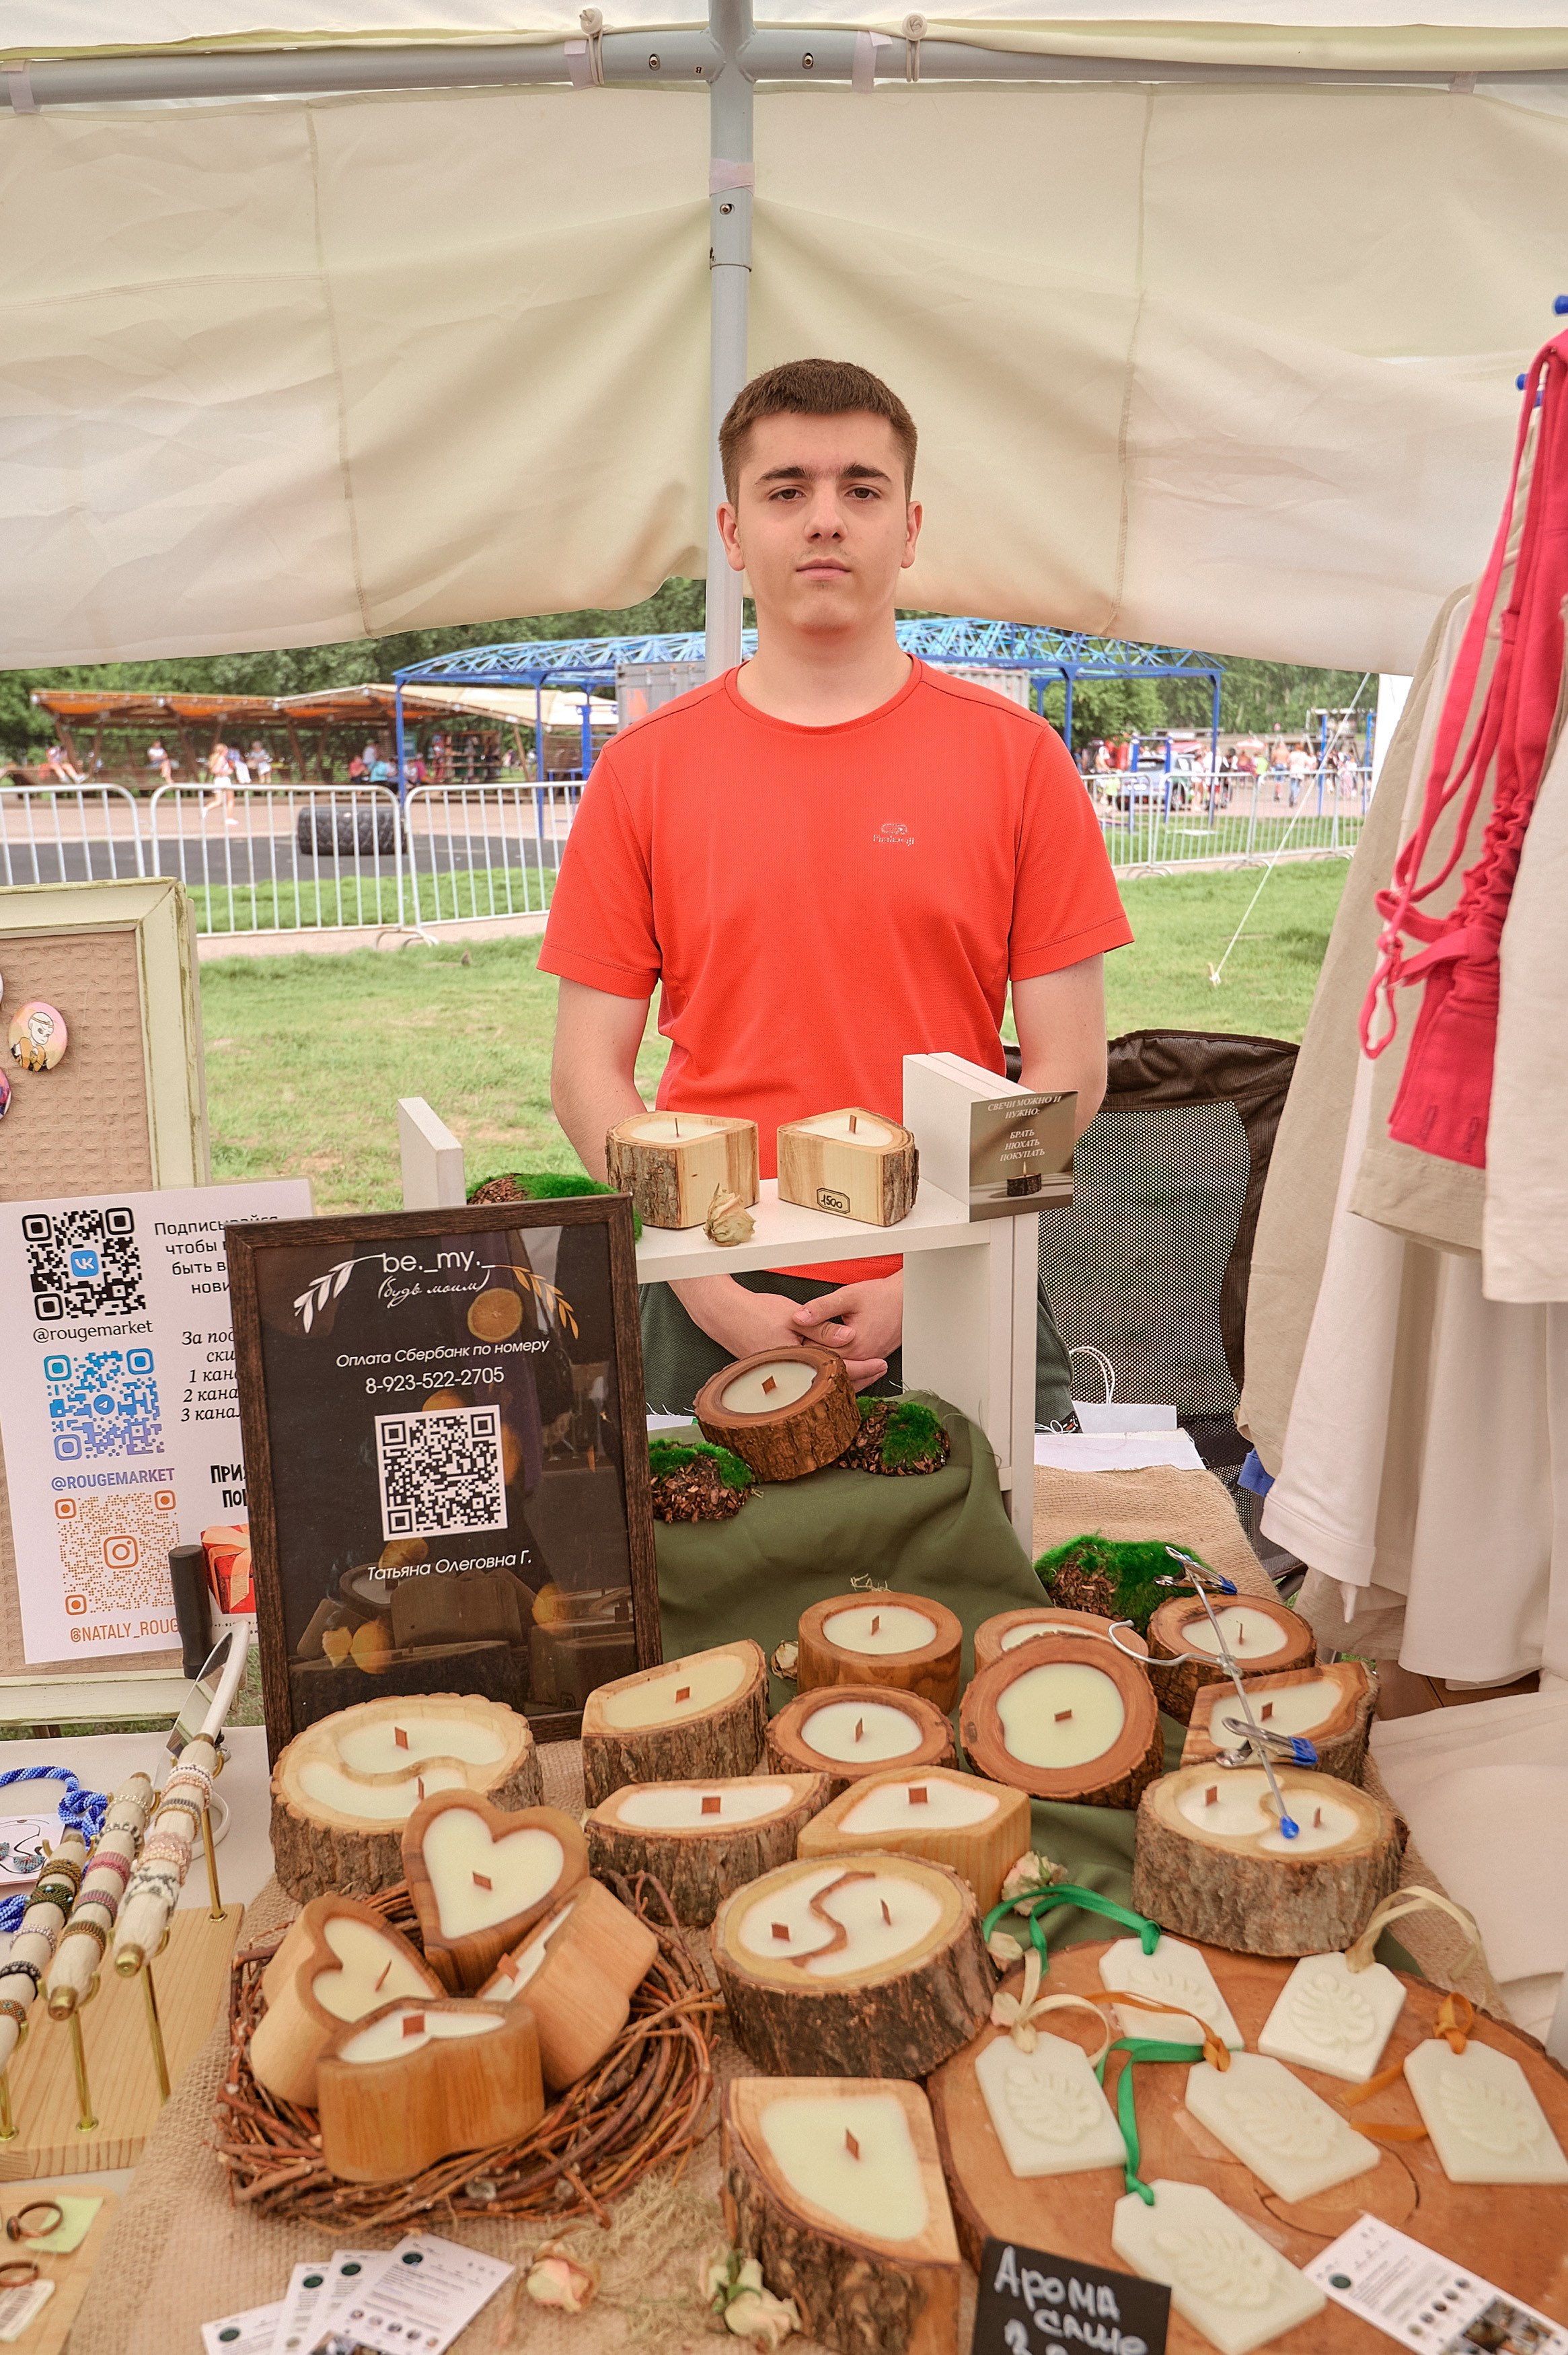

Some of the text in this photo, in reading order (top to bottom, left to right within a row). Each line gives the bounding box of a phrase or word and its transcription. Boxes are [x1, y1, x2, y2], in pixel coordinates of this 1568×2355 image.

[987, 1100, 1016, 1111] СВЕЧИ
[1016, 1097, 1052, 1108] МОЖНО
[1005, 1108, 1041, 1119] НУЖНО:
[1010, 1129, 1035, 1139] БРАТЬ
[1005, 1139, 1040, 1151] НЮХАТЬ
[1000, 1149, 1045, 1161] ПОКУПАТЬ
[821, 1194, 843, 1209] 1500
[165, 1239, 217, 1254] чтобы
[172, 1262, 212, 1275] быть
[33, 1320, 153, 1343] @rougemarket
[182, 1331, 202, 1345] За
[336, 1339, 550, 1367] Оплата Сбербанк по номеру
[189, 1369, 237, 1383] 1 кан
[365, 1367, 505, 1393] 8-923-522-2705
[183, 1389, 193, 1403] 2
[181, 1408, 190, 1422] 3
[51, 1468, 175, 1491] @ROUGEMARKET
[211, 1463, 246, 1484] ПРИ
[367, 1550, 532, 1581] Татьяна Олеговна Г.
